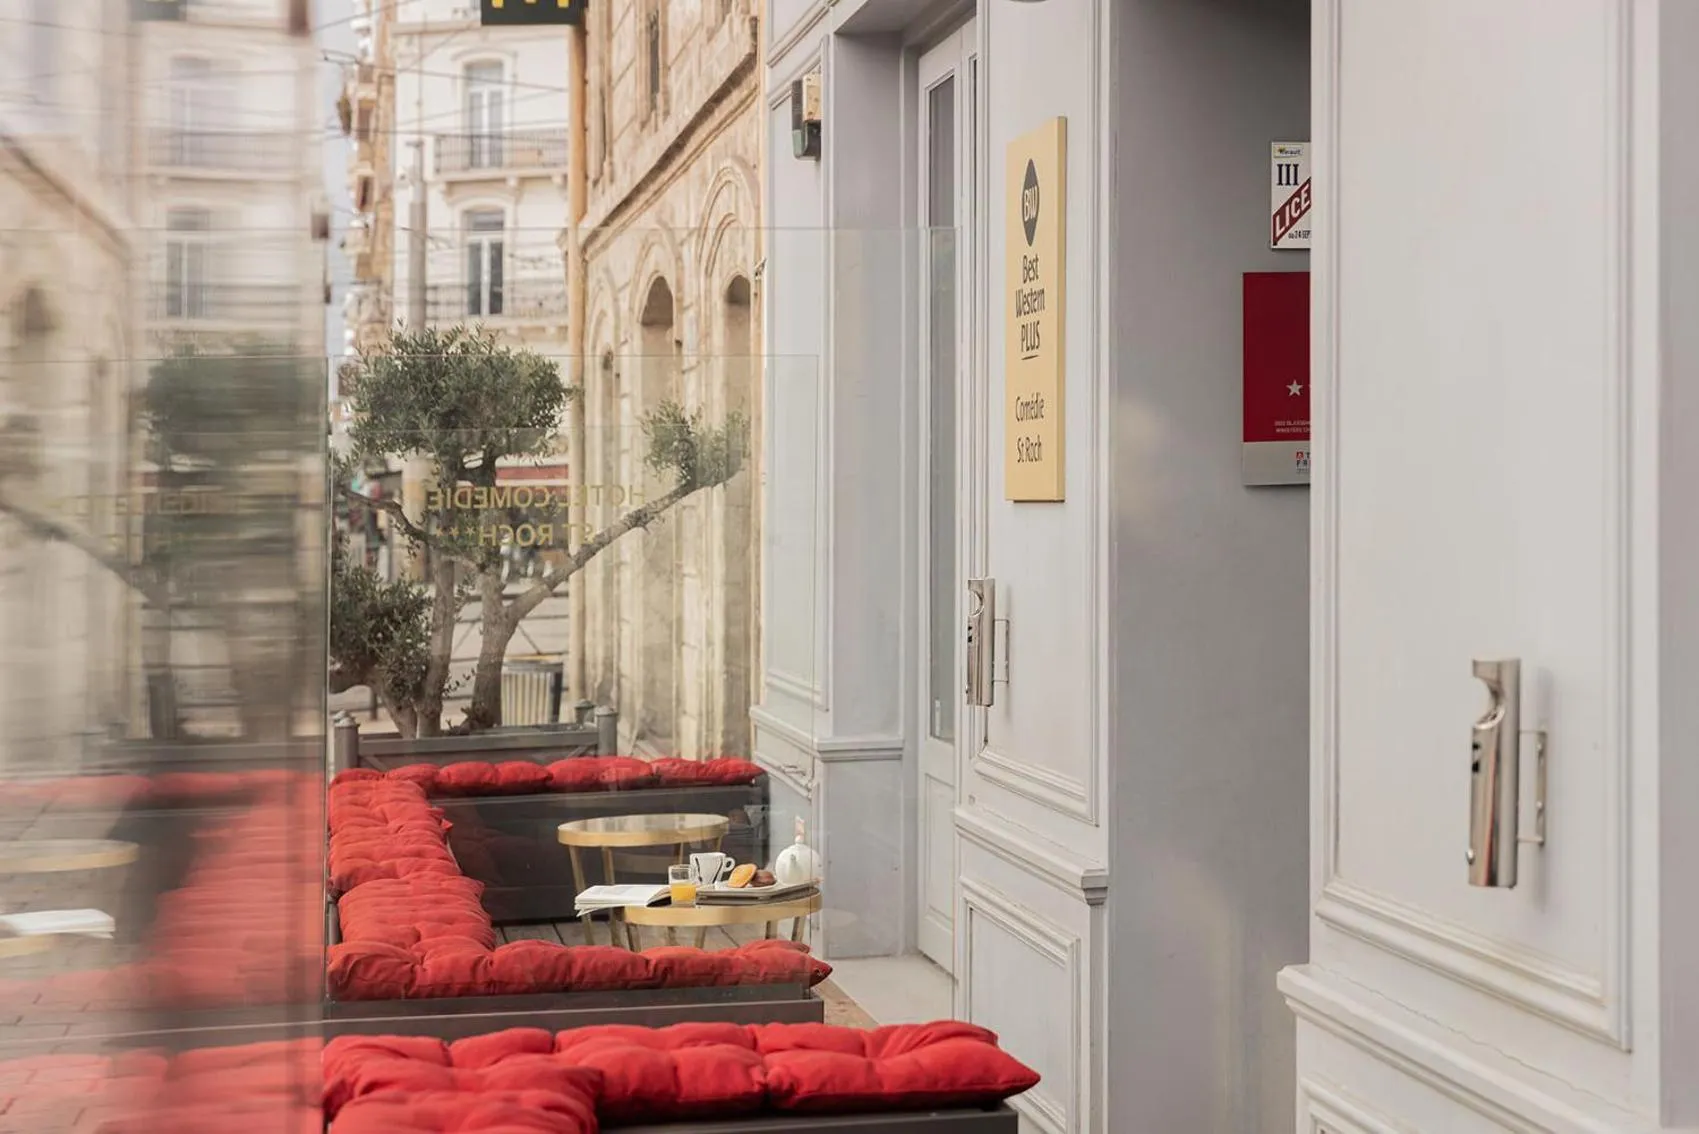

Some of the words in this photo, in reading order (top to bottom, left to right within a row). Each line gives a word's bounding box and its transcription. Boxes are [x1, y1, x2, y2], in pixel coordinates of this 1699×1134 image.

[1277, 164, 1299, 186] III
[1024, 186, 1038, 222] BW
[1022, 254, 1039, 284] Best
[1015, 287, 1045, 318] Western
[1021, 321, 1040, 352] PLUS
[1015, 392, 1044, 422] Comédie
[1025, 434, 1042, 462] Roch
